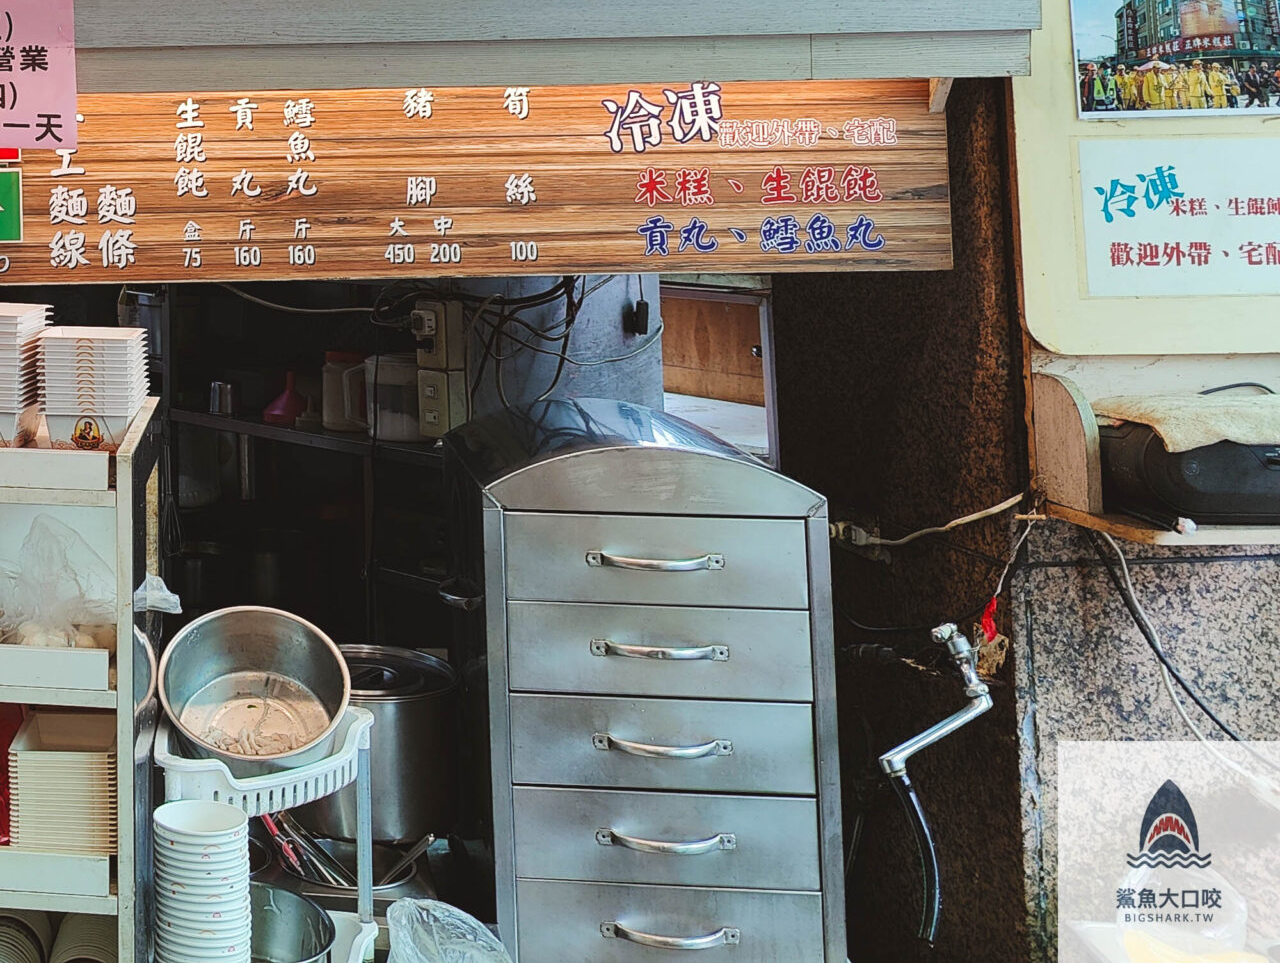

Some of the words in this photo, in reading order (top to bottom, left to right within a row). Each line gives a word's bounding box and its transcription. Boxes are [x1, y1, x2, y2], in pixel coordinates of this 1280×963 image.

[601, 81, 723, 154] 冷凍
[717, 118, 898, 148] 歡迎外帶、宅配
[173, 97, 209, 199] 生餛飩
[229, 98, 262, 198] 貢丸
[282, 97, 319, 198] 鱈魚丸
[401, 87, 437, 207] 豬腳
[502, 86, 538, 206] 筍絲
[634, 165, 884, 208] 米糕、生餛飩
[1094, 165, 1185, 224] 冷凍
[97, 184, 139, 269] 麵條
[183, 220, 202, 242] 盒
[237, 218, 256, 241] 斤
[292, 217, 312, 240] 斤
[388, 216, 410, 237] 大
[432, 215, 454, 237] 中
[637, 213, 886, 257] 貢丸、鱈魚丸
[183, 247, 202, 268] 75
[234, 244, 262, 267] 160
[287, 244, 316, 267] 160
[383, 243, 416, 264] 450
[429, 242, 462, 264] 200
[509, 240, 539, 262] 100
